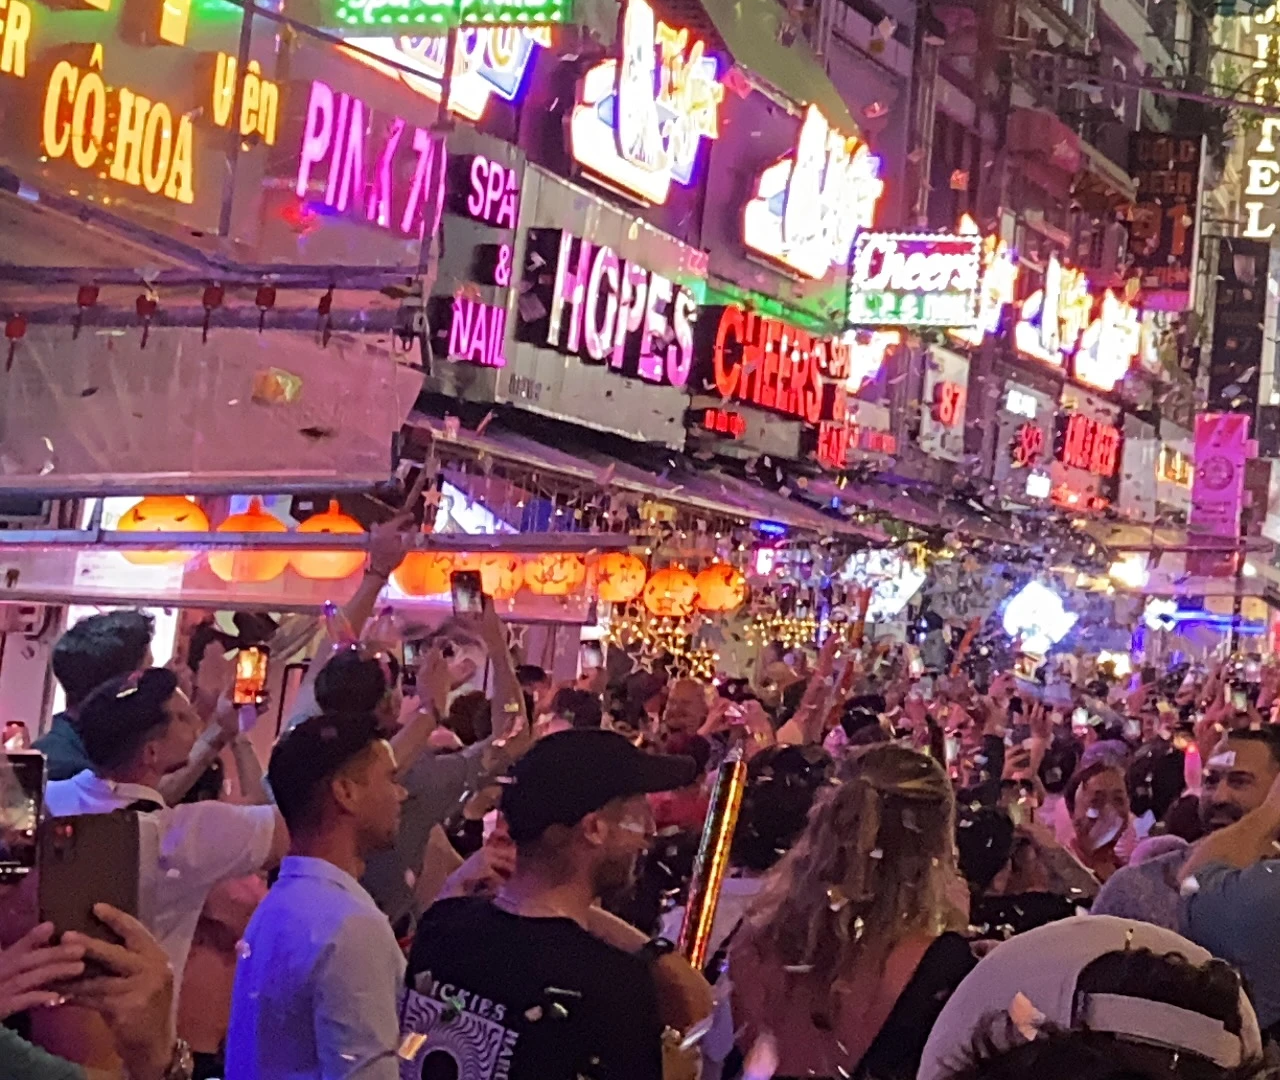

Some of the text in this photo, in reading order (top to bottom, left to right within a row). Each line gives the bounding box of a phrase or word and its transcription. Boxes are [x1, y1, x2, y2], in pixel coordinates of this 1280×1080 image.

[43, 42, 195, 205] CÔ HOA
[468, 155, 518, 229] SPA
[494, 243, 511, 287] &
[852, 233, 977, 292] Cheers
[447, 295, 507, 368] NAIL
[546, 229, 697, 388] HOPES
[715, 304, 827, 424] CHEERS
[428, 979, 508, 1021] ICKIES
